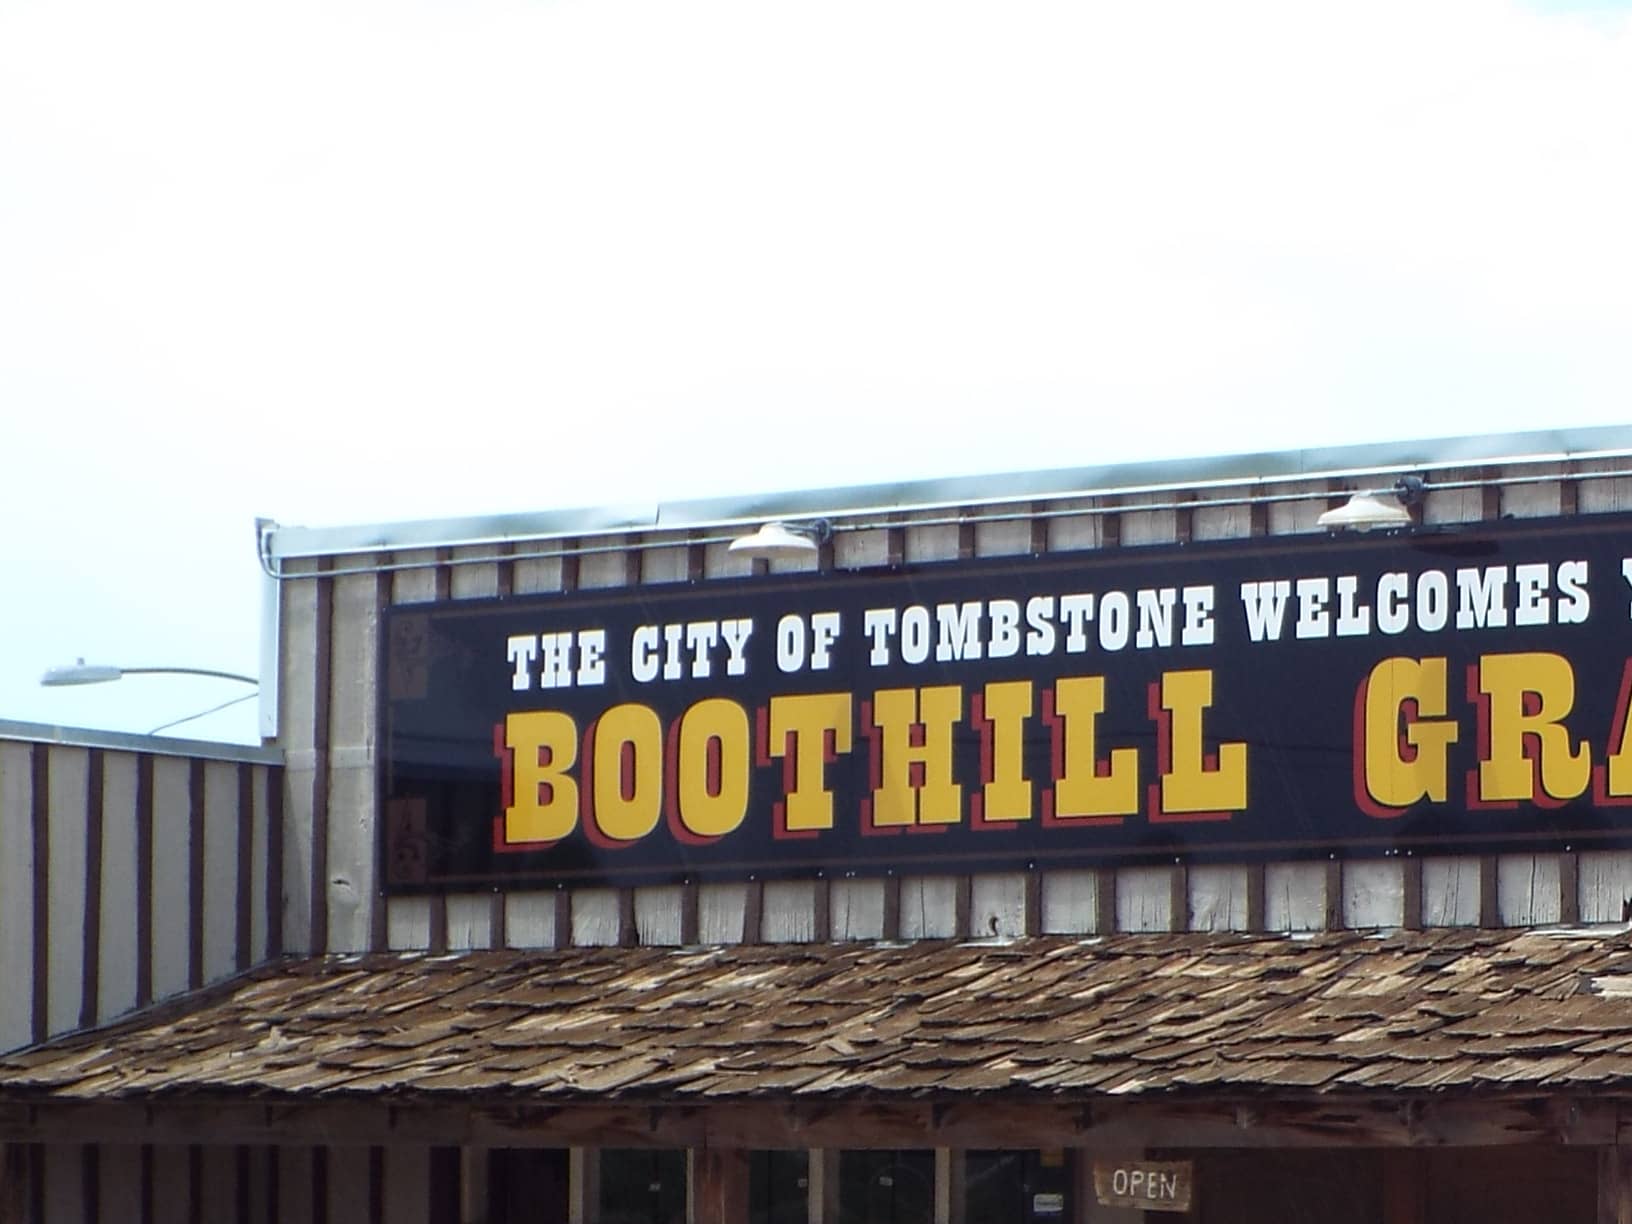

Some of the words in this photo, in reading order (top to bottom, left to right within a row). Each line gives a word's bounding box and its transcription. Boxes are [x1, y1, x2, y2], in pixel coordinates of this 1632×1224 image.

[507, 629, 606, 691] THE
[631, 618, 753, 683] CITY
[776, 612, 841, 673] OF
[864, 585, 1215, 666] TOMBSTONE
[1240, 560, 1591, 642] WELCOMES
[496, 669, 1248, 850] BOOTHILL
[1113, 1169, 1177, 1199] OPEN
